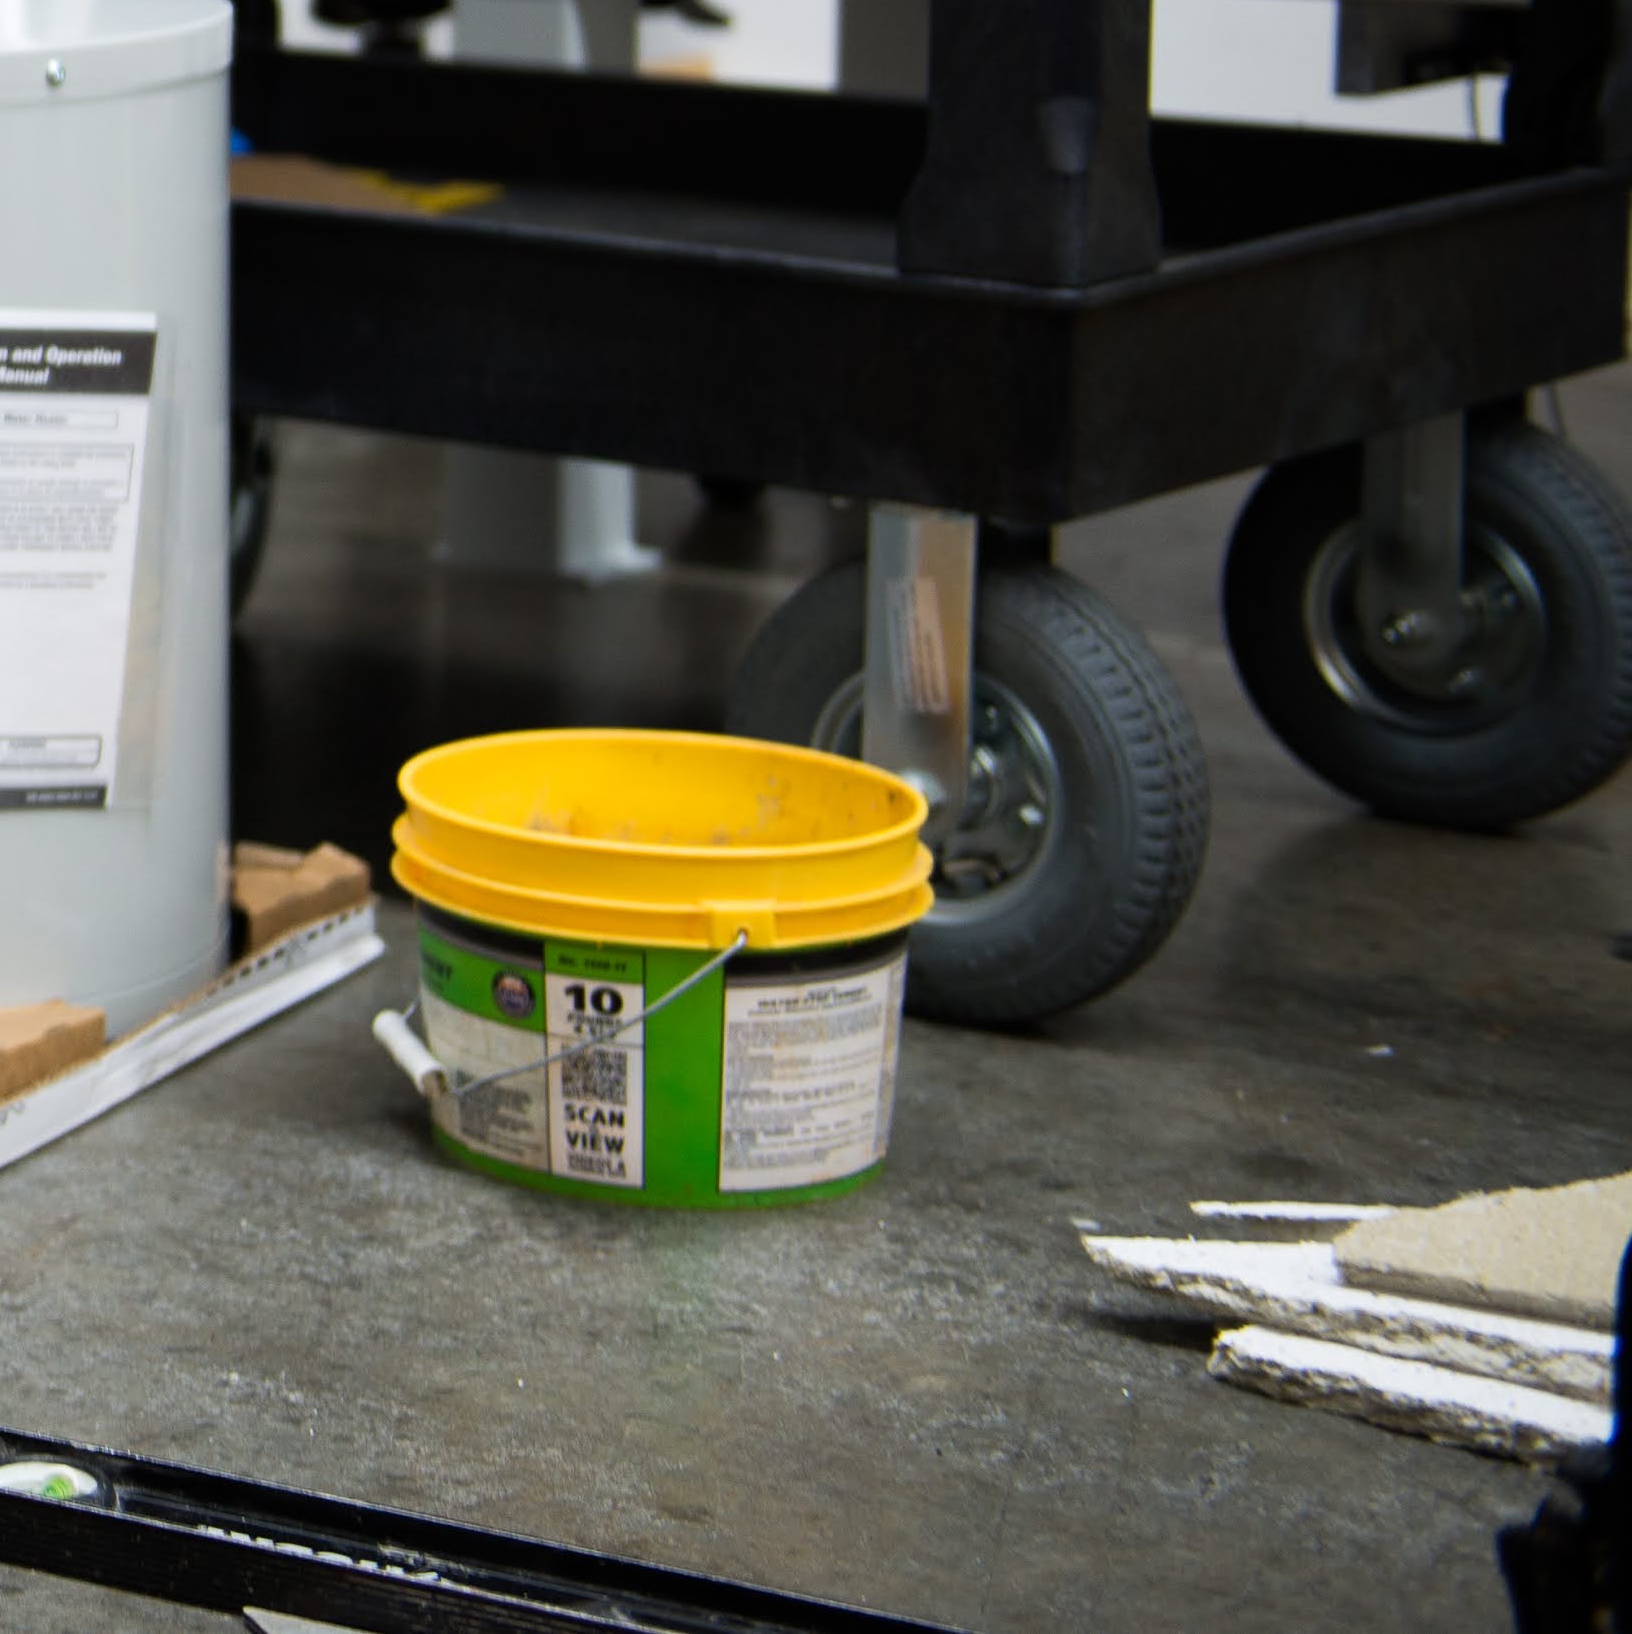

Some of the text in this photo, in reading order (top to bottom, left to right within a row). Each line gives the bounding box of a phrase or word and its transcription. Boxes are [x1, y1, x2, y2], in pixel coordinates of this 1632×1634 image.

[12, 345, 43, 363] and
[46, 345, 123, 366] Operation
[564, 984, 624, 1015] 10
[564, 1102, 625, 1127] SCAN
[566, 1129, 625, 1154] VIEW
